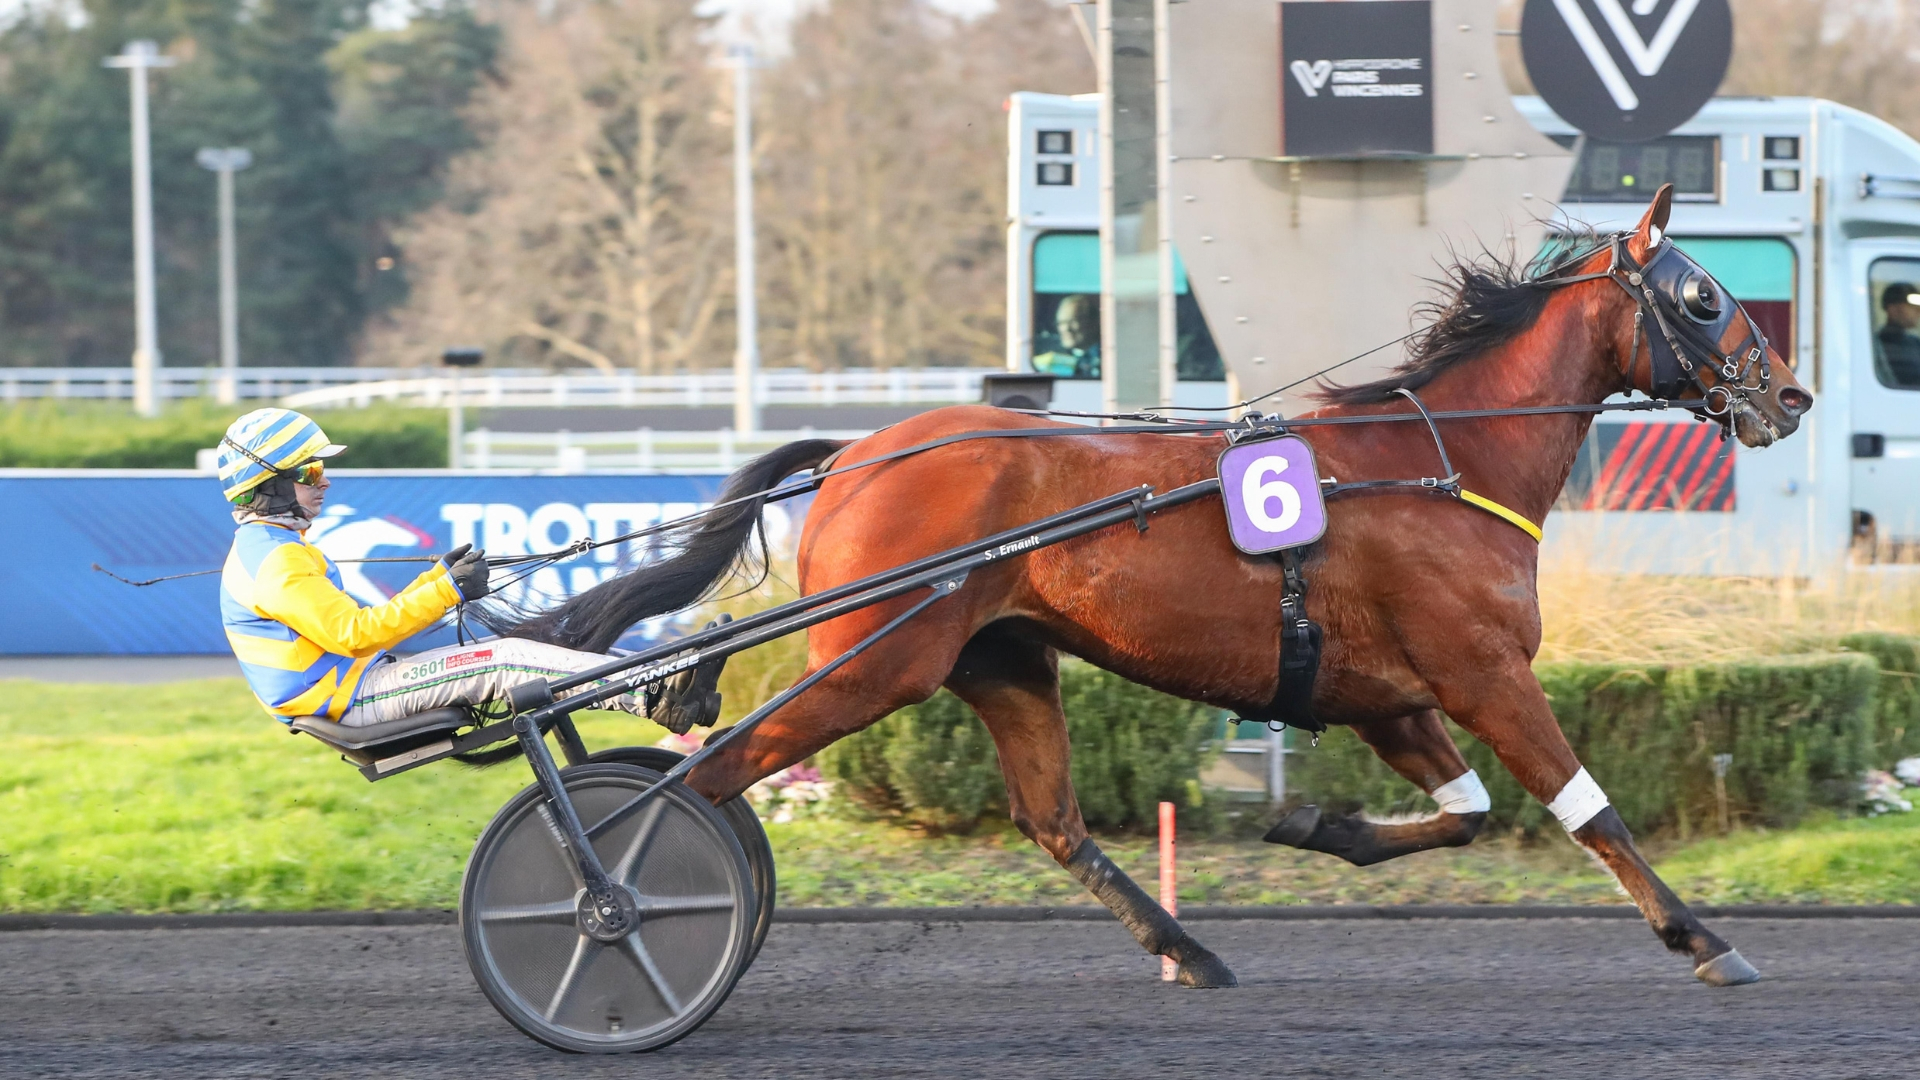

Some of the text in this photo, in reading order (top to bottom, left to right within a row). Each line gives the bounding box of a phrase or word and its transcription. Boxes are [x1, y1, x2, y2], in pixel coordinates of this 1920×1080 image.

[1242, 455, 1301, 533] 6
[984, 535, 1040, 561] S. Ernault
[457, 652, 476, 660] LIGNE
[461, 655, 492, 665] COURSES
[410, 657, 445, 680] 3601
[625, 653, 700, 687] YANKEE
